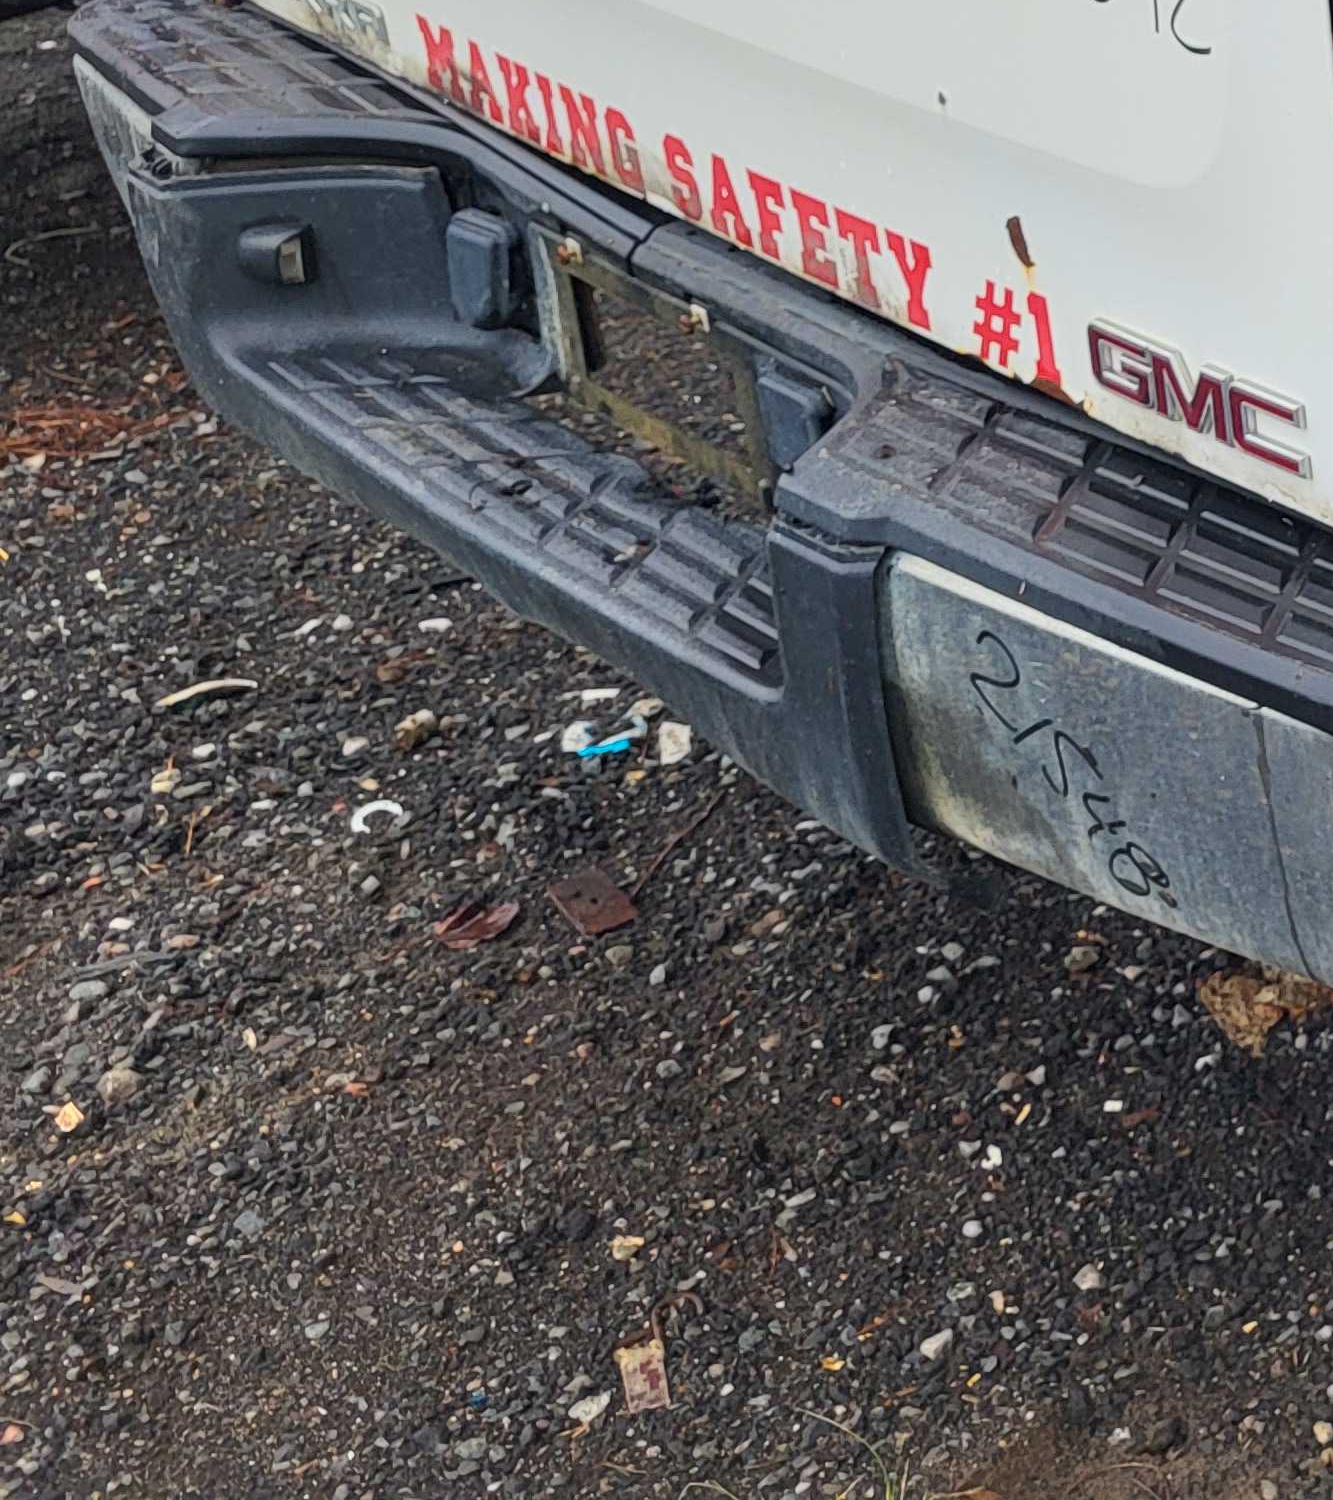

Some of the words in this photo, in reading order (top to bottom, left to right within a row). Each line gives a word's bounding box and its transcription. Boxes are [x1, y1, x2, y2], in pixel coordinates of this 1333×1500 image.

[416, 13, 646, 192] MAKING
[662, 133, 933, 332] SAFETY
[973, 279, 1062, 383] #1
[1087, 316, 1314, 480] GMC
